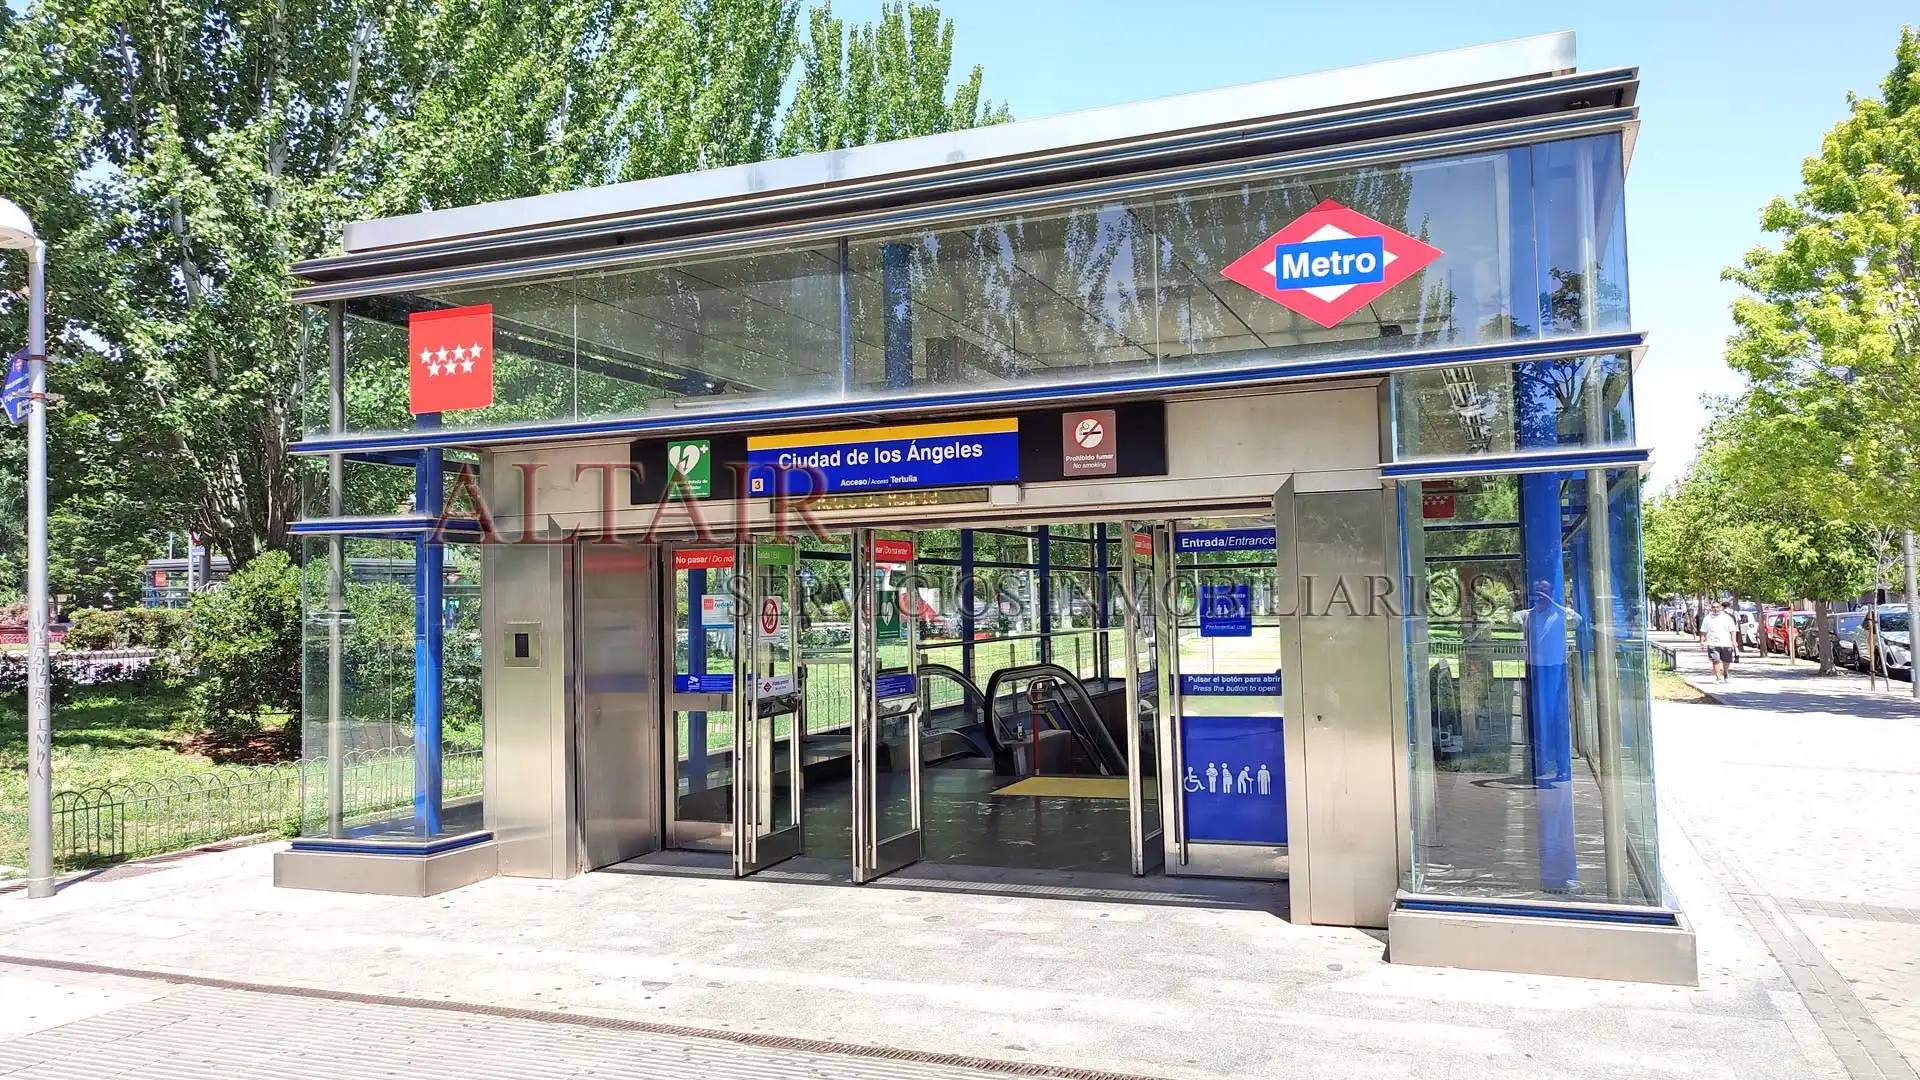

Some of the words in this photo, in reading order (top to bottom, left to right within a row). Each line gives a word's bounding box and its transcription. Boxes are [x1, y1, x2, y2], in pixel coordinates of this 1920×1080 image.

[1283, 250, 1376, 279] Metro
[779, 450, 840, 470] Ciudad
[847, 448, 869, 465] de
[874, 447, 902, 464] los
[907, 440, 983, 464] Ángeles
[1082, 461, 1107, 469] smoking
[890, 474, 918, 484] Tertulia
[754, 480, 761, 490] 3
[675, 556, 686, 564] No
[688, 556, 708, 566] pasar
[712, 554, 722, 563] Do
[1213, 675, 1220, 683] el
[1221, 675, 1243, 683] botón
[1245, 676, 1261, 684] para
[1263, 674, 1280, 682] abrir
[1226, 684, 1248, 692] button
[1258, 685, 1276, 693] open
